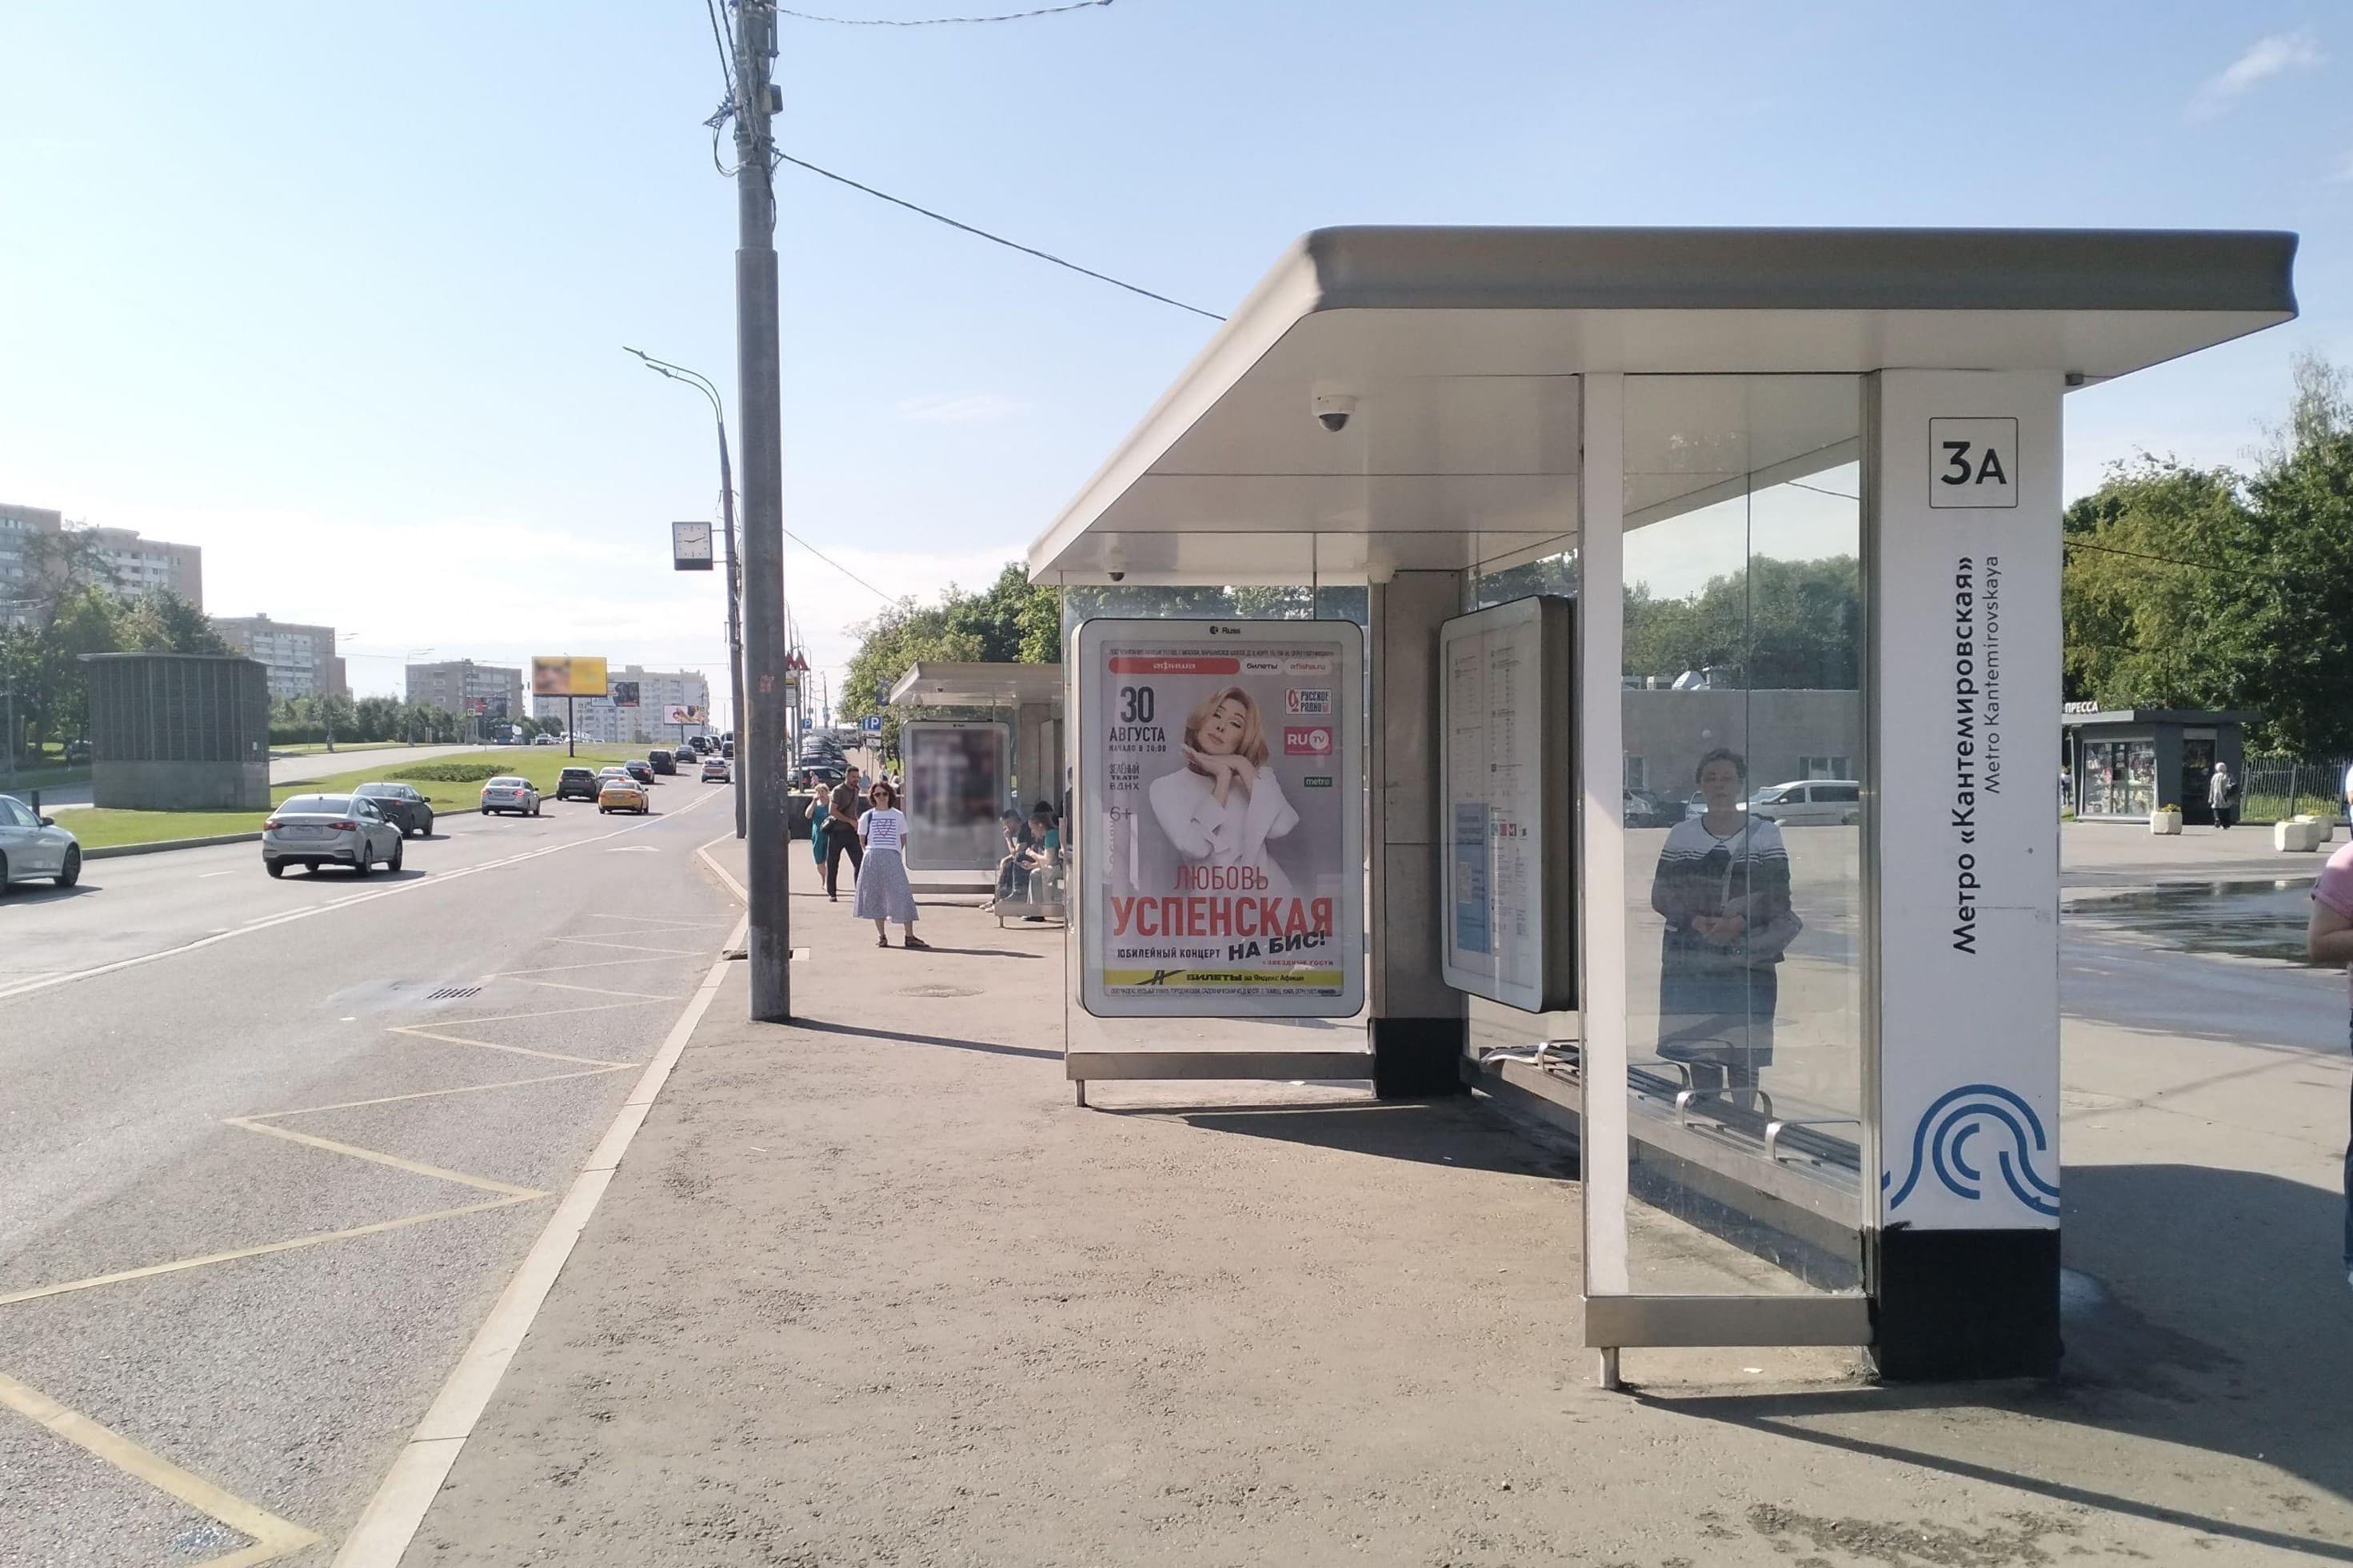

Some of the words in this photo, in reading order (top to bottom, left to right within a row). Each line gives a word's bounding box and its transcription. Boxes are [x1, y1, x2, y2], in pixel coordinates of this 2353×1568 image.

[1982, 557, 2002, 725] Kantemirovskaya
[1153, 661, 1196, 670] афиша
[1300, 691, 1329, 701] РУССКОЕ
[1952, 557, 1979, 844] «Кантемировская»
[1121, 686, 1154, 723] 30
[1300, 703, 1322, 712] РАДИО
[2065, 701, 2099, 712] ПРЕССА
[871, 717, 880, 730] P
[1109, 726, 1165, 742] АВГУСТА
[1287, 734, 1308, 745] RU
[1984, 733, 2000, 793] Metro
[1110, 806, 1133, 822] 6+
[1173, 866, 1268, 891] ЛЮБОВЬ
[1953, 853, 1981, 954] Метро
[1111, 896, 1332, 937] УСПЕНСКАЯ
[1117, 947, 1176, 958] ЮБИЛЕЙНЫЙ
[1180, 948, 1220, 960] КОНЦЕРТ
[1228, 941, 1261, 961] НА
[1268, 930, 1326, 954] БИС!
